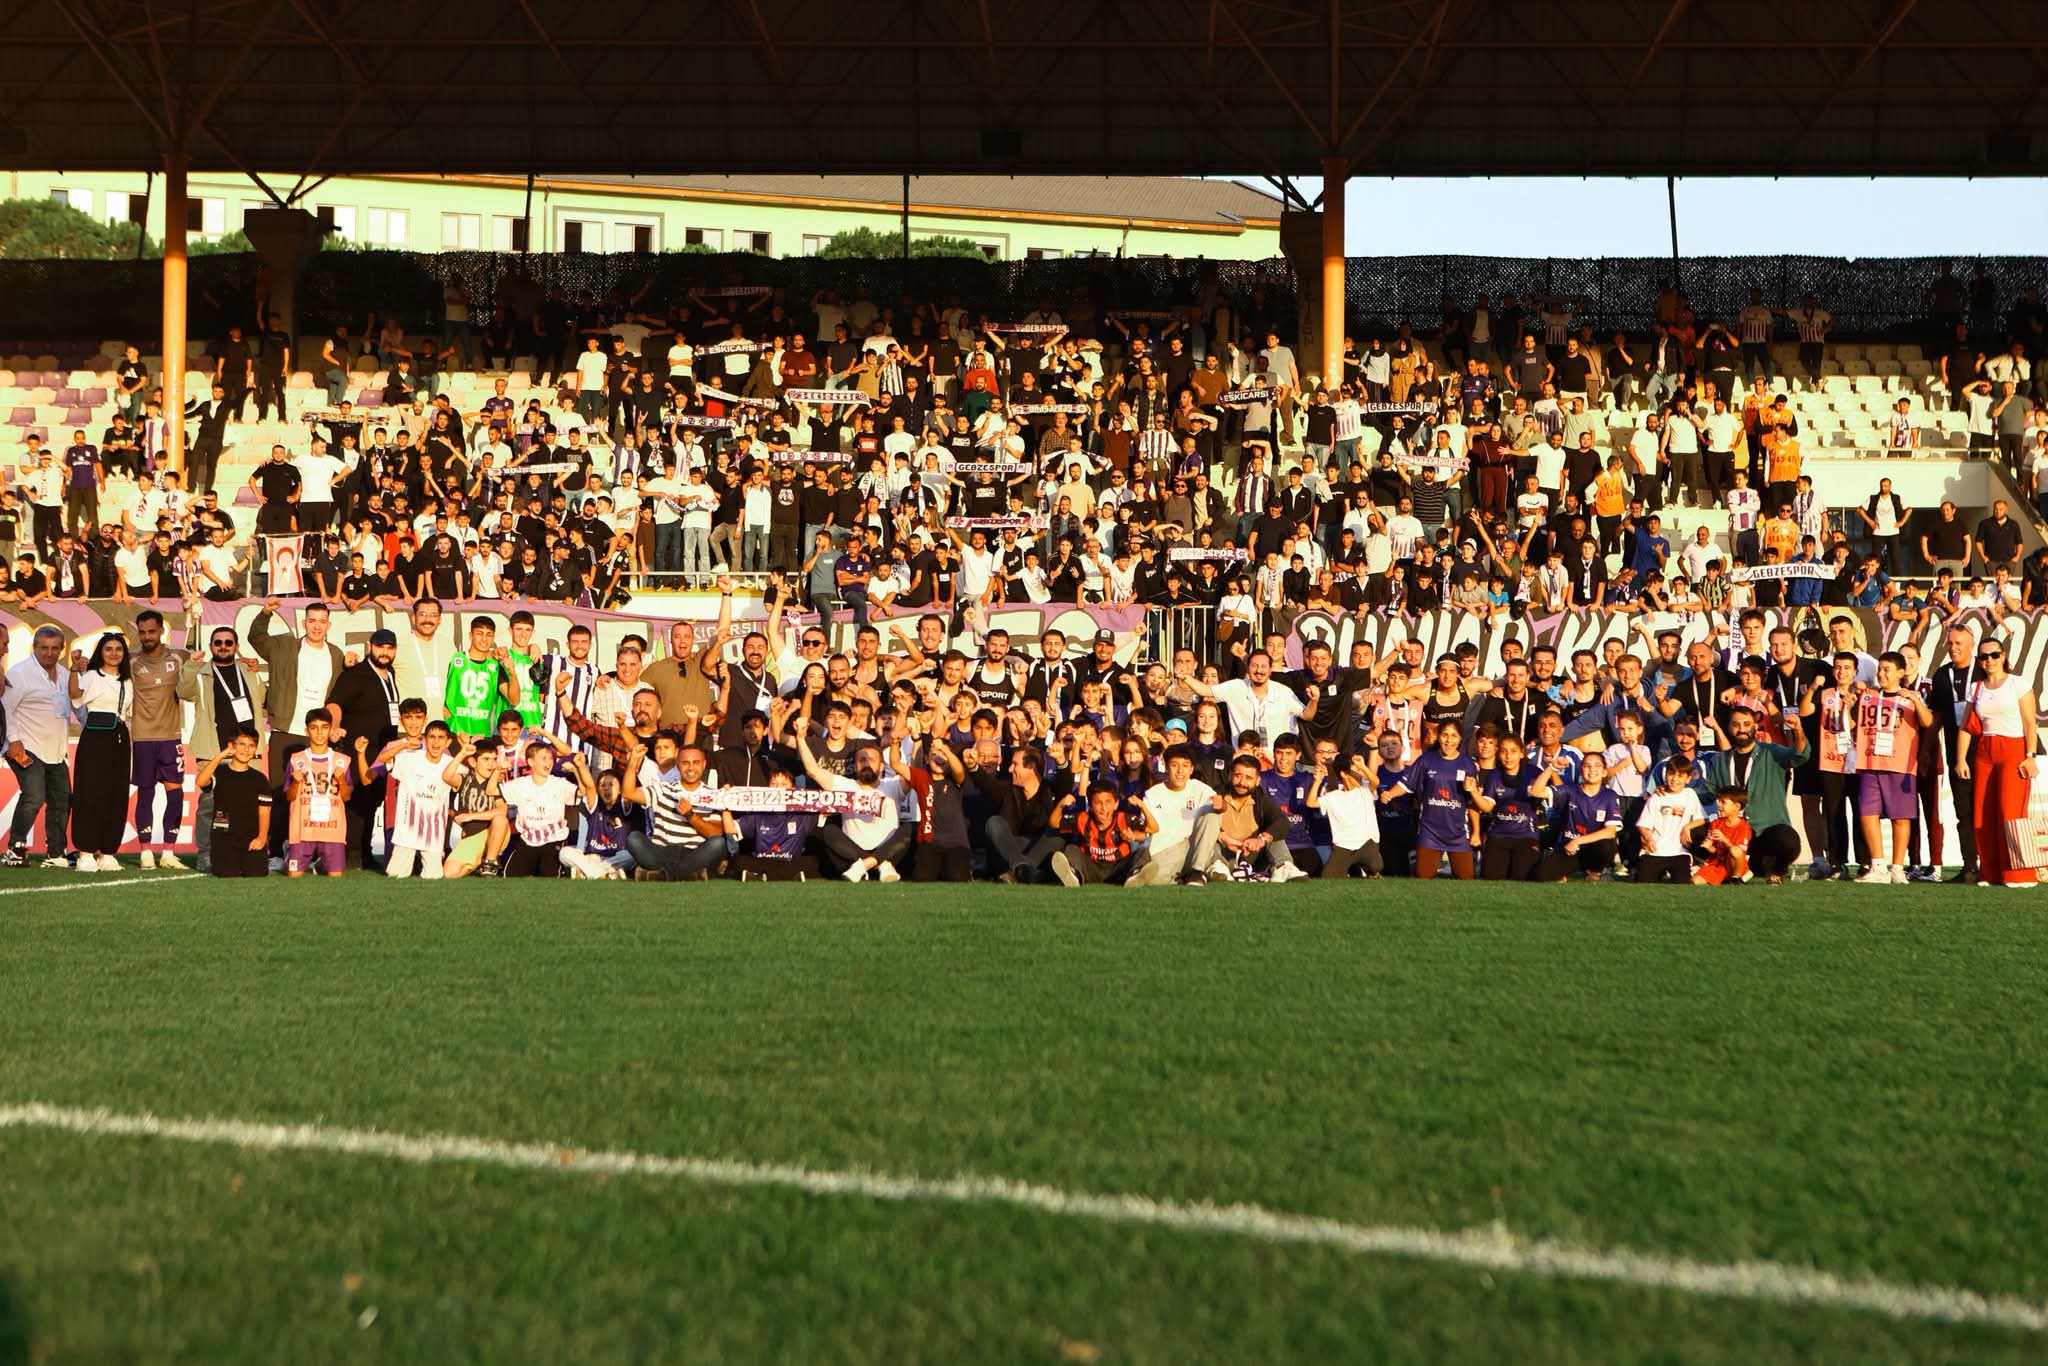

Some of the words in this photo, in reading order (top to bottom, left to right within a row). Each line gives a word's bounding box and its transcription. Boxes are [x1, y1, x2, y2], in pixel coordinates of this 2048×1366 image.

[1370, 402, 1422, 411] GEBZESPOR
[958, 463, 1015, 472] GEBZESPOR
[1753, 565, 1814, 579] GEBZESPOR
[461, 669, 491, 701] 05
